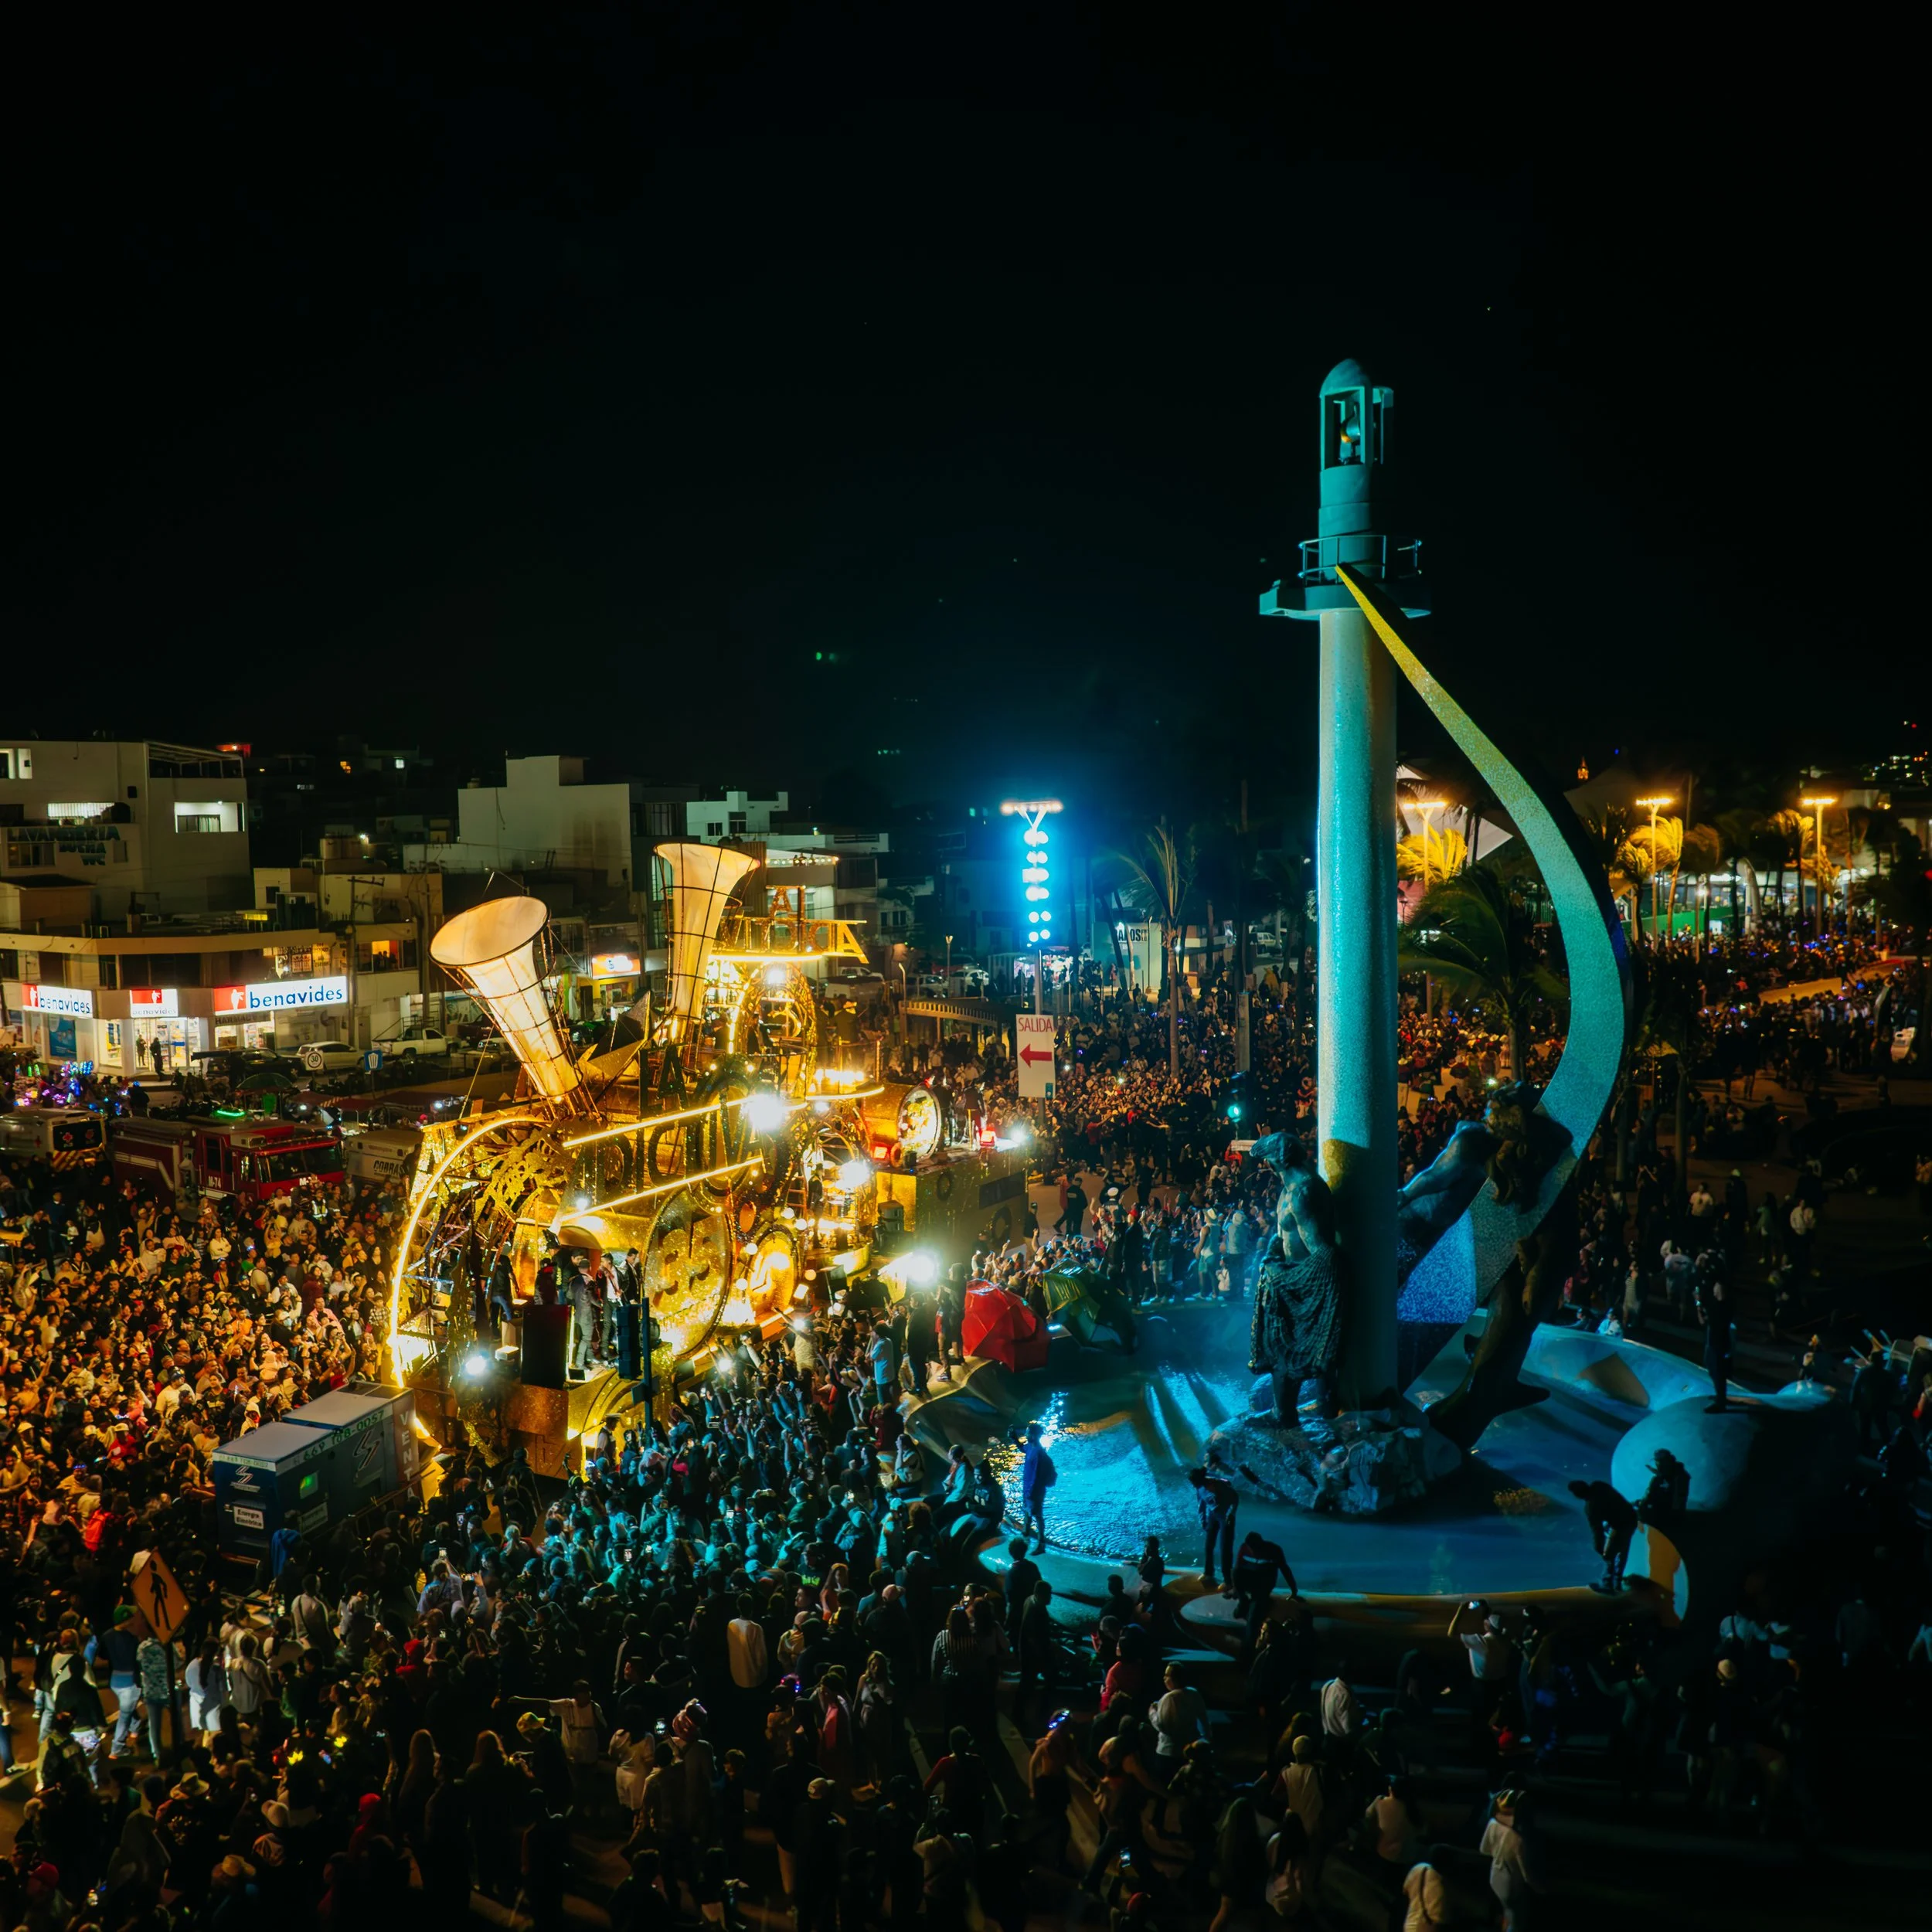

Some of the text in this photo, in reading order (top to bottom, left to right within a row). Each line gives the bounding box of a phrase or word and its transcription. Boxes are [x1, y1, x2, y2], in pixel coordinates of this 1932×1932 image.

[39, 991, 90, 1014] benavides
[250, 985, 342, 1009] benavides
[1018, 1017, 1053, 1032] SALIDA
[208, 1175, 222, 1189] M-74
[400, 1411, 416, 1502] VENTA
